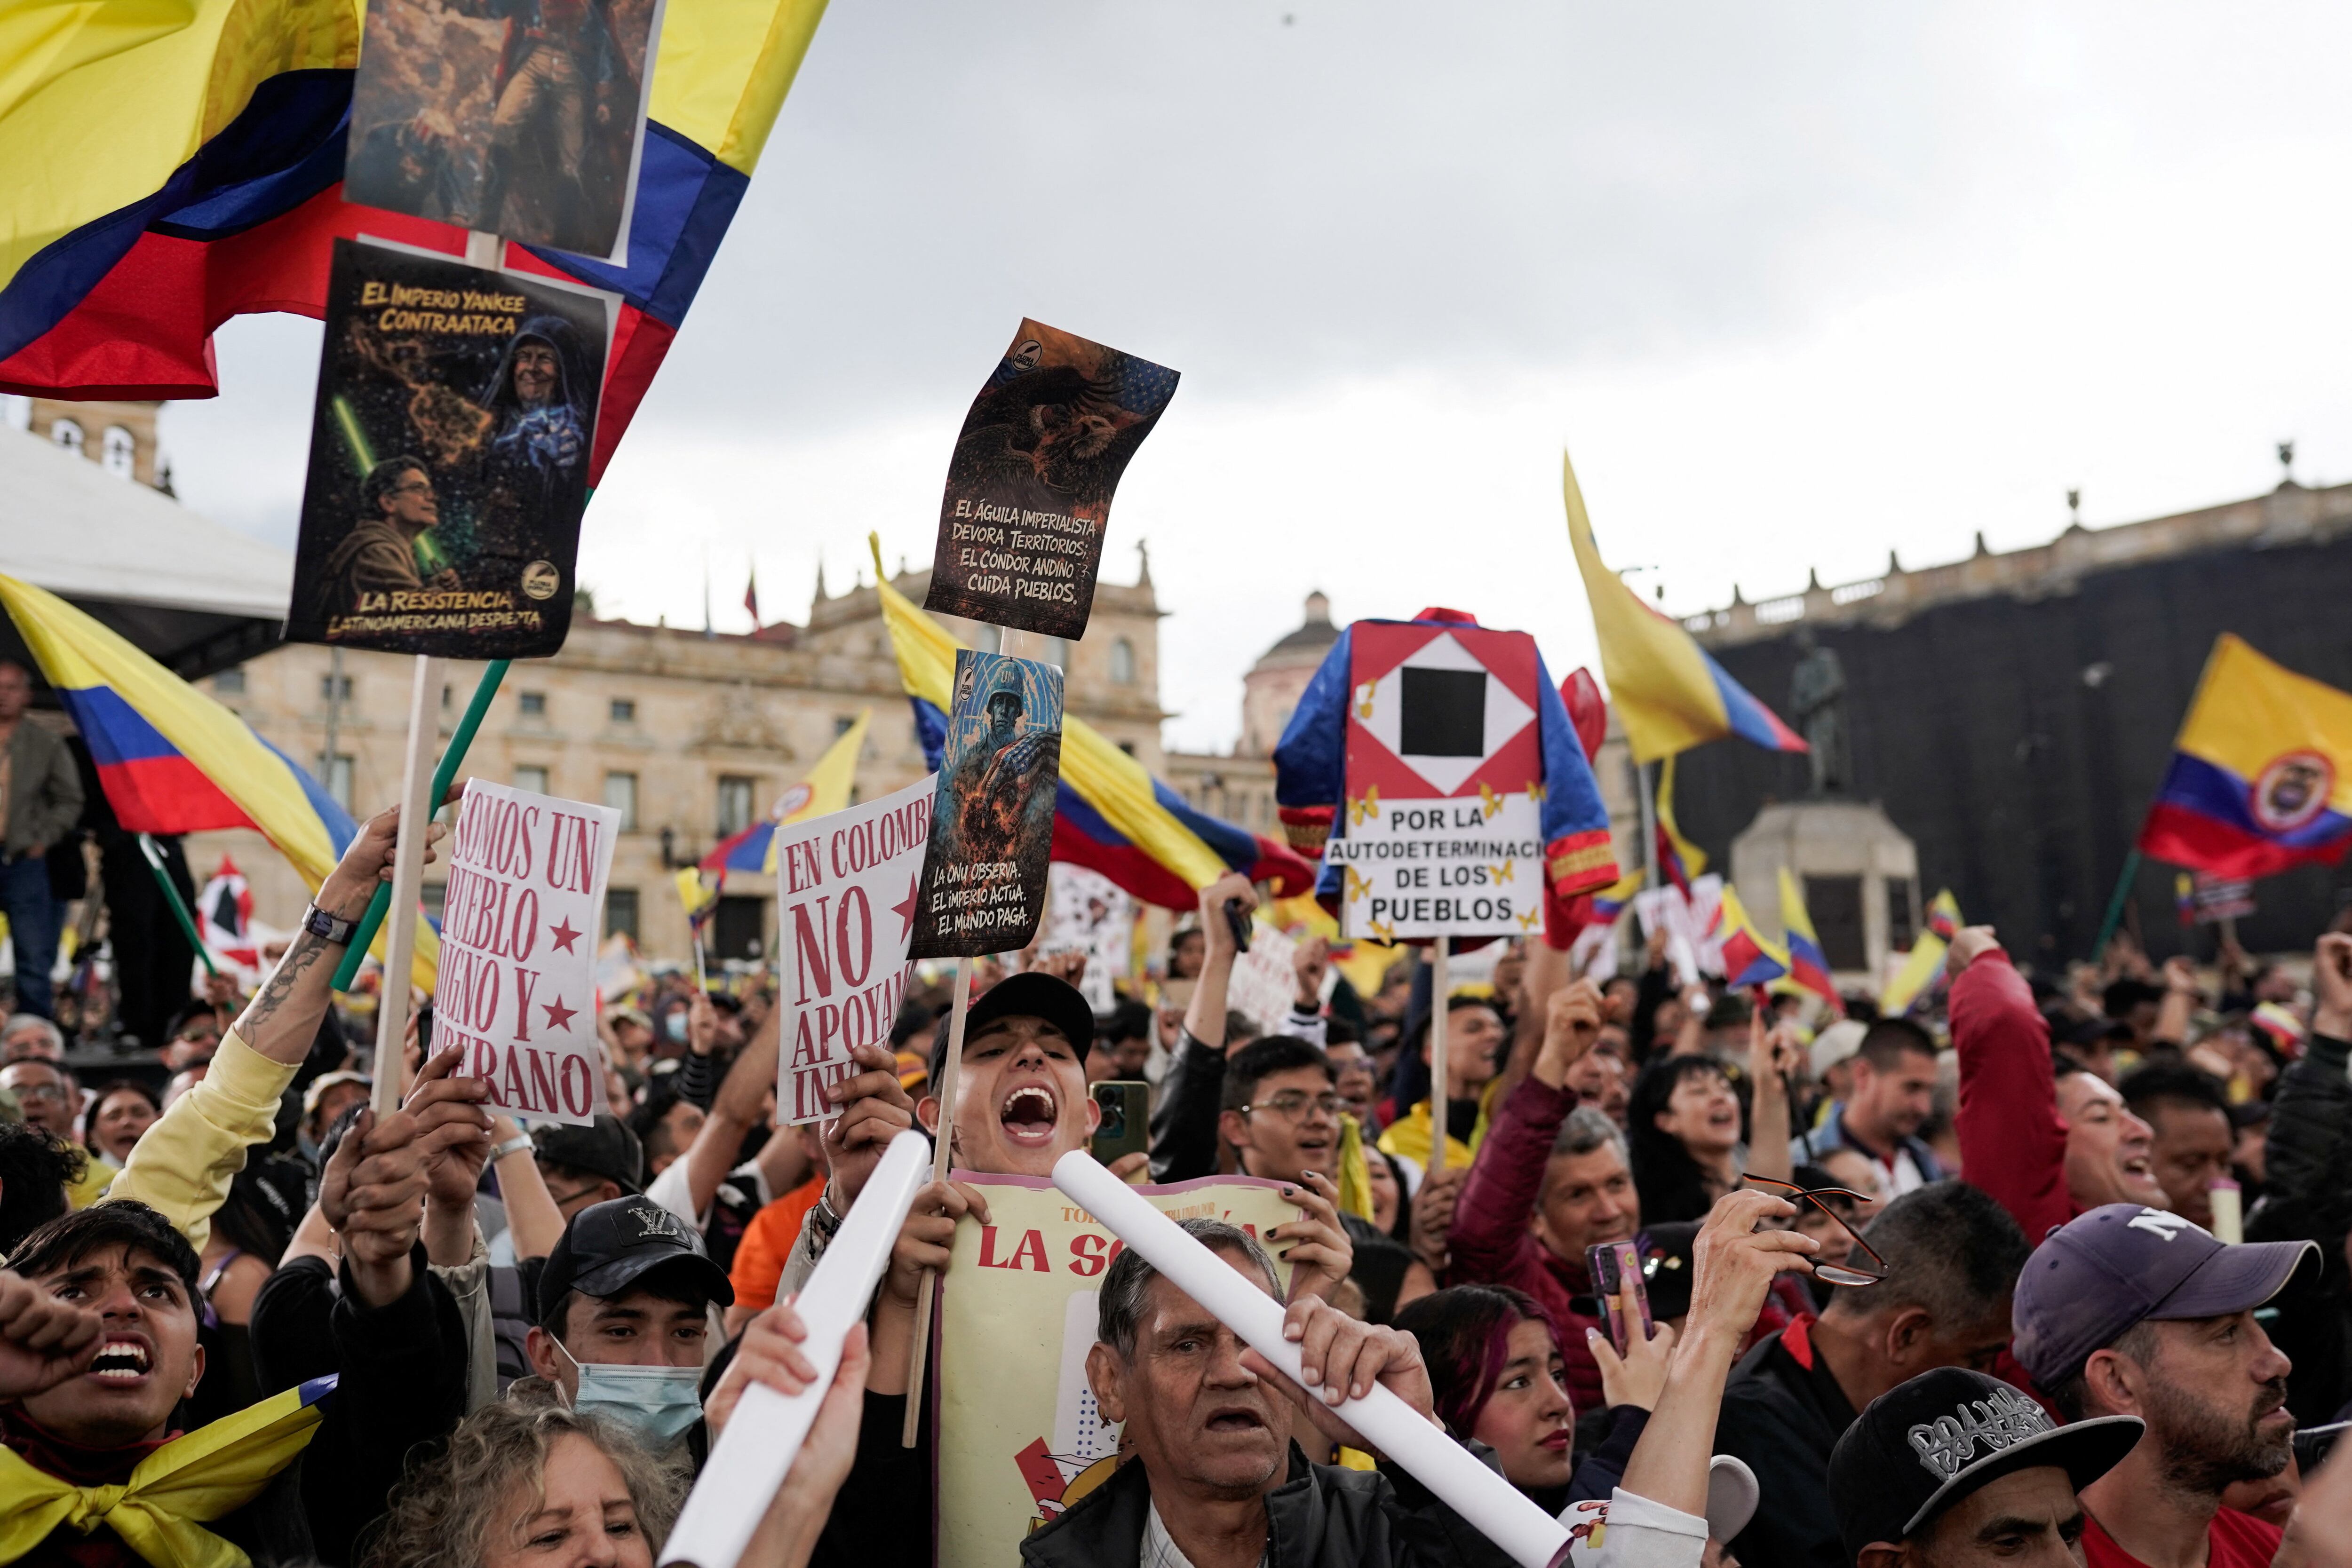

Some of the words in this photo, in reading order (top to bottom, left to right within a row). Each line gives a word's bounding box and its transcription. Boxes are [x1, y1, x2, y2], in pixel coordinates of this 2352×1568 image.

[362, 282, 389, 305] EL
[391, 283, 460, 309] IMPERIO
[461, 291, 526, 312] YANKEE
[380, 308, 516, 334] CONTRAATACA
[955, 499, 972, 518] EL
[974, 499, 1019, 526] ÁGUILA
[1021, 510, 1096, 538] IMPERIALISTA
[952, 523, 1004, 545] DEVORA
[960, 548, 977, 567] EL
[980, 547, 1030, 573] CÓNDOR
[1032, 557, 1074, 578] ANDINO
[359, 591, 388, 611] LA
[390, 591, 513, 612] RESISTENCIA
[326, 613, 467, 634] LATINOAMERICANA
[1391, 809, 1445, 832] POR
[1455, 808, 1484, 828] LA
[547, 812, 600, 895] UN
[785, 837, 822, 895] EN
[933, 866, 945, 888] LA
[947, 863, 968, 883] ONU
[971, 861, 1021, 881] OBSERVA.
[1397, 868, 1428, 888] DE
[1440, 866, 1487, 887] LOS
[441, 864, 538, 962] PUEBLO
[932, 891, 946, 913] EL
[1372, 898, 1512, 921] PUEBLOS
[938, 915, 952, 935] EL
[955, 911, 994, 933] MUNDO
[997, 906, 1029, 928] PAGA.
[790, 886, 872, 1006] NO
[433, 939, 500, 1032] DIGNO
[513, 967, 540, 1042] Y
[978, 1225, 1050, 1273] LA
